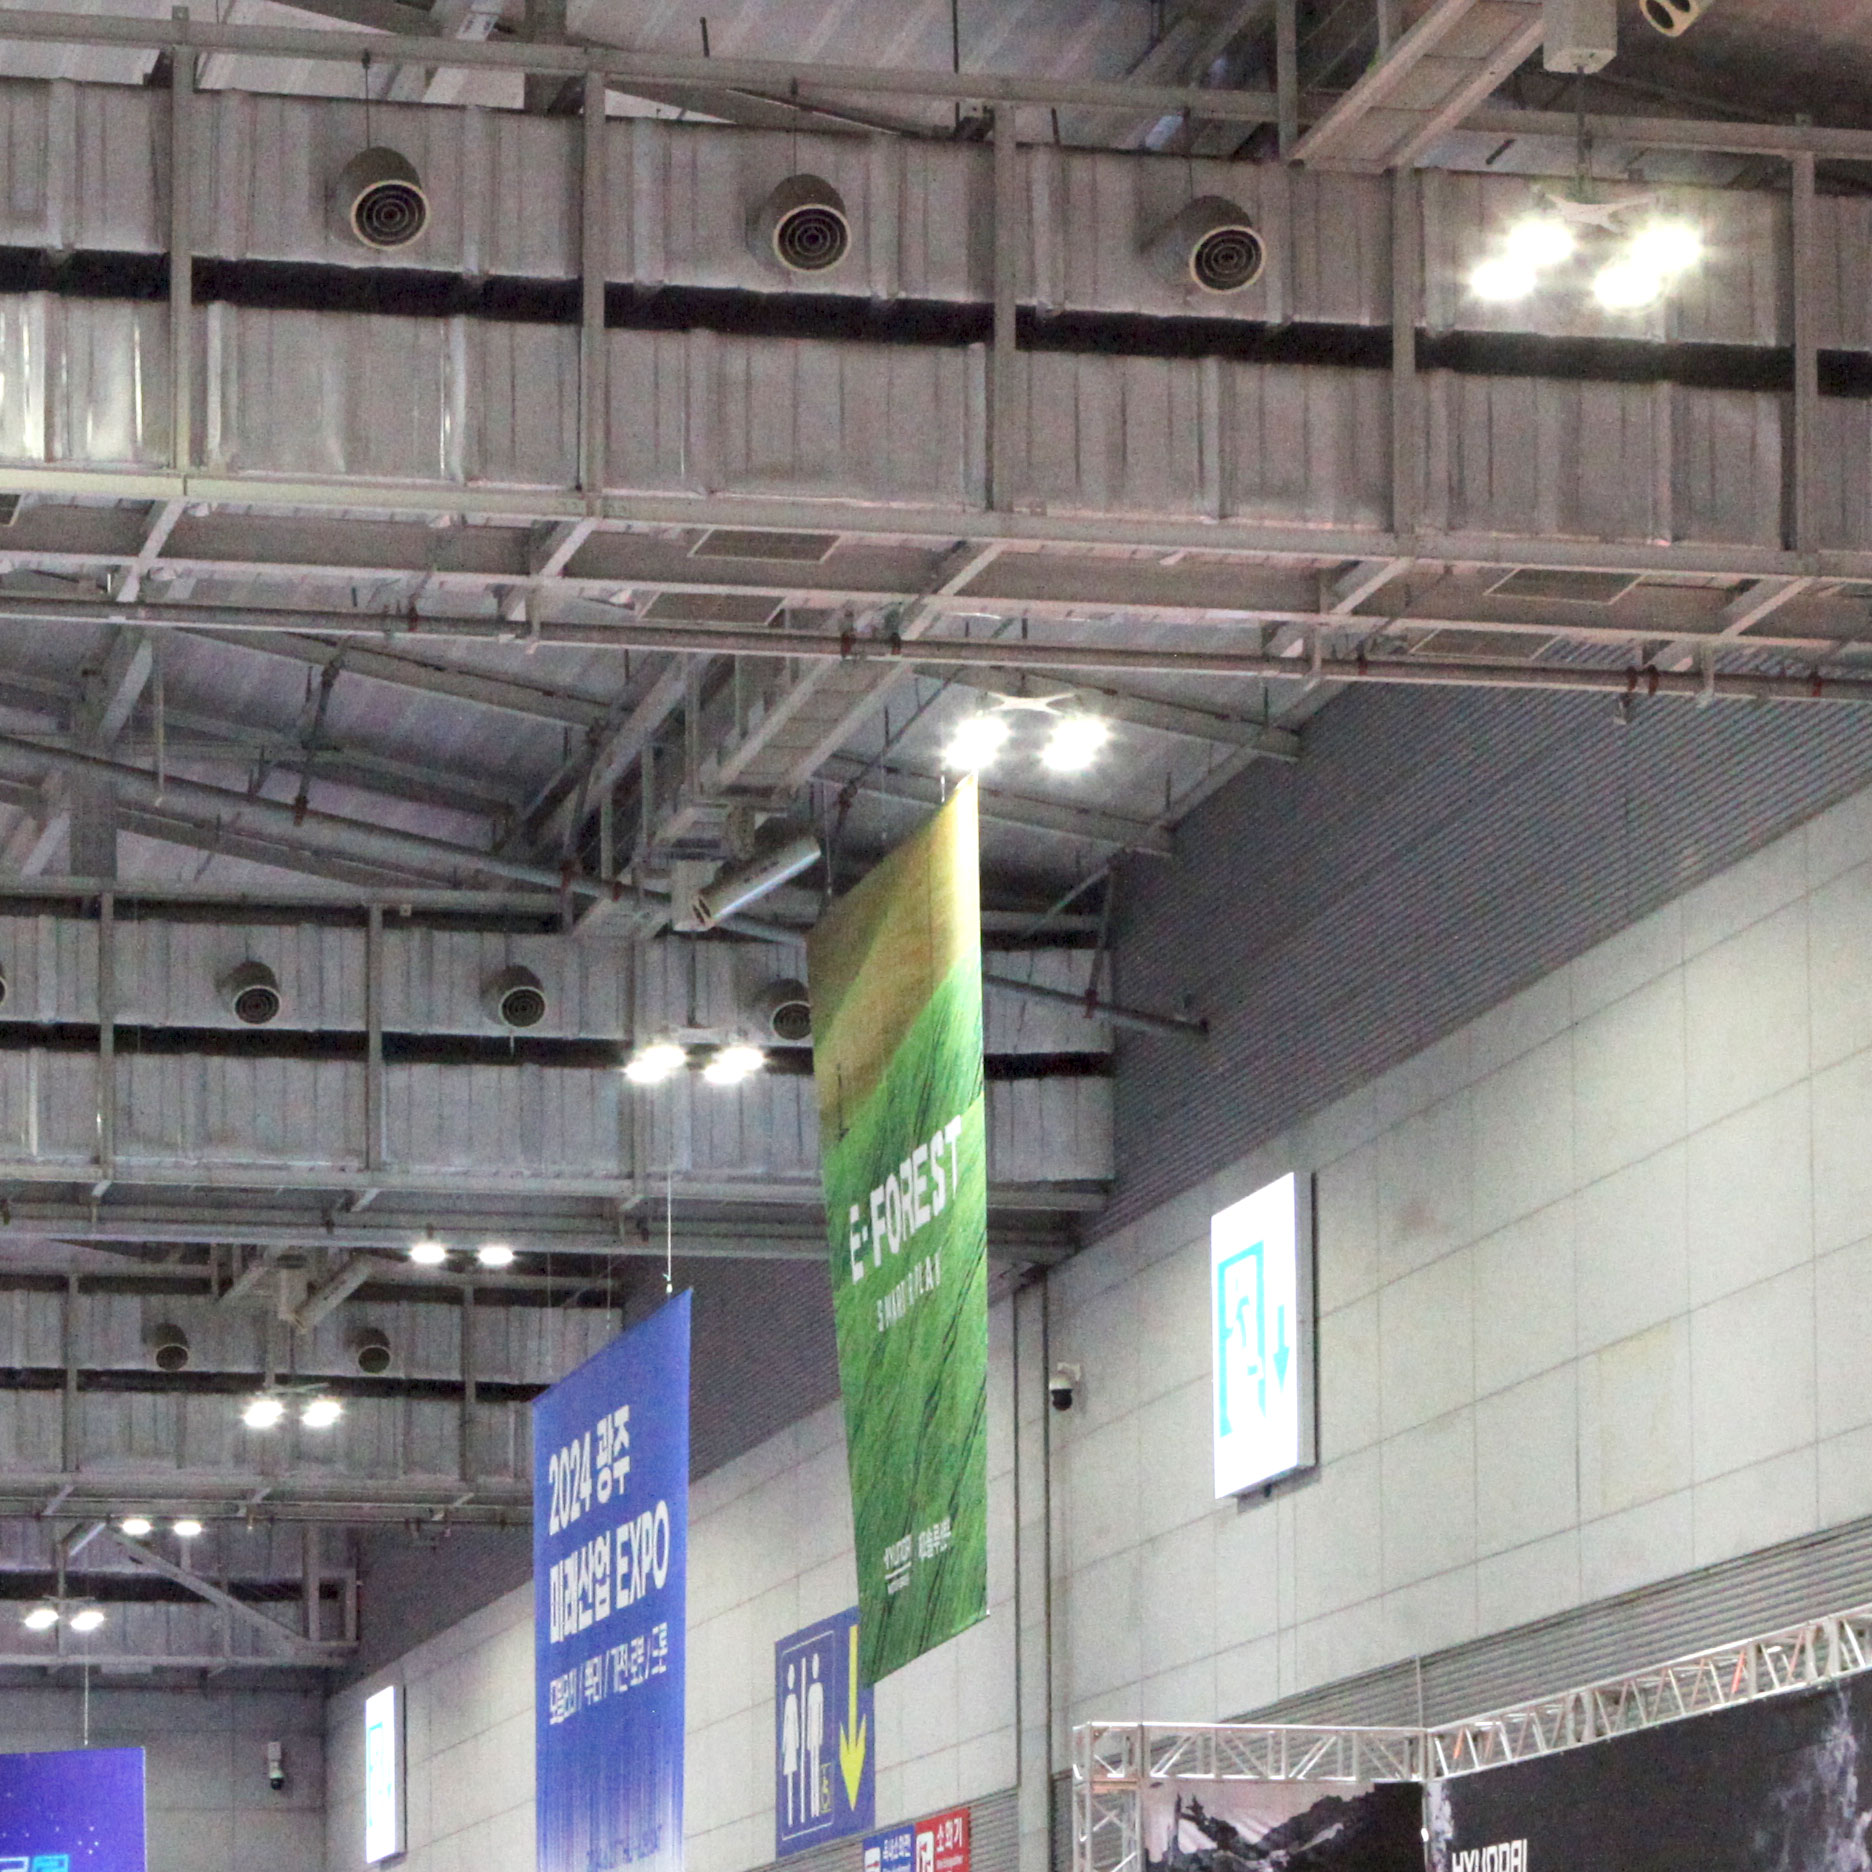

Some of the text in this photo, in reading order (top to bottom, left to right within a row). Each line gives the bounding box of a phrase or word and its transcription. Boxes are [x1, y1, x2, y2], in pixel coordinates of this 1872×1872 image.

[849, 1114, 962, 1285] E-FOREST
[549, 1405, 630, 1536] 2024 광주
[616, 1500, 670, 1610] EXPO
